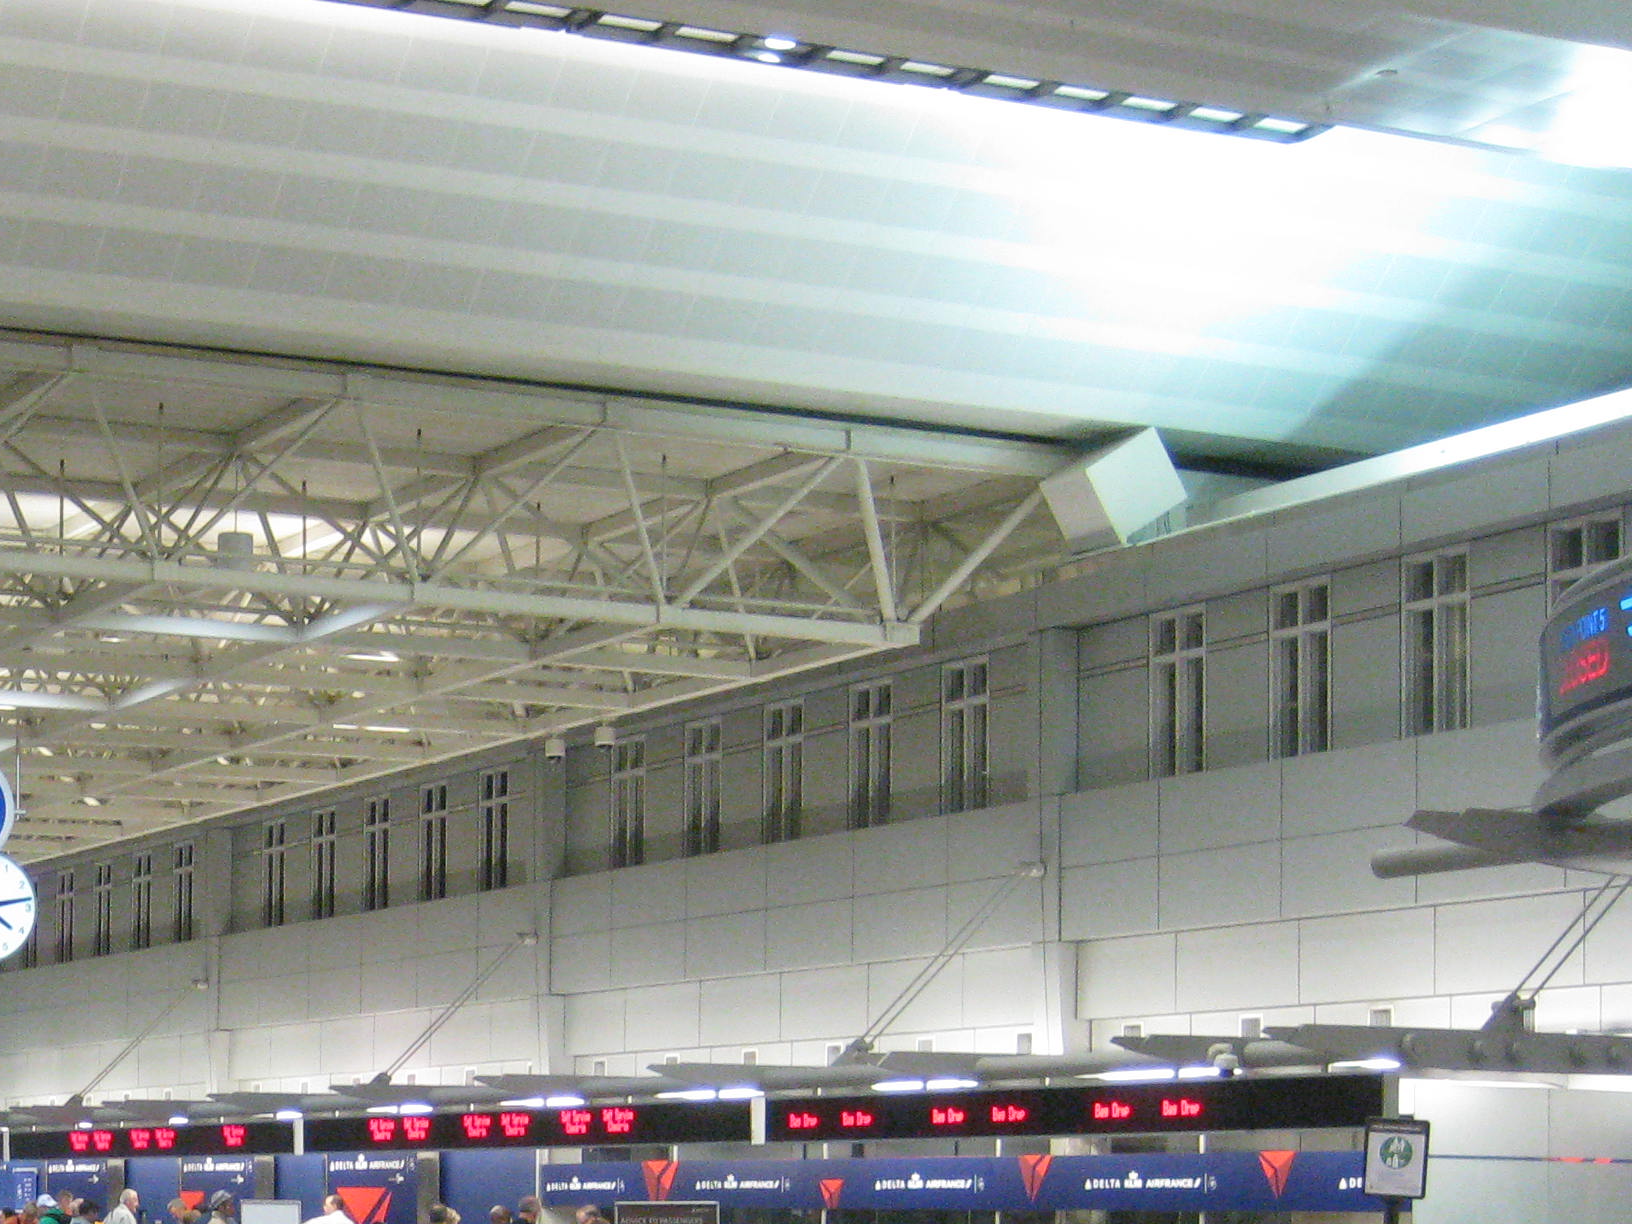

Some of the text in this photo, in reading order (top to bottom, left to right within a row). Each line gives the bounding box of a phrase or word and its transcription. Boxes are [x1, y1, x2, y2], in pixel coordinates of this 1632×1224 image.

[5, 864, 9, 872] 1
[19, 880, 25, 889] 2
[25, 904, 31, 912] 3
[19, 926, 24, 934] 4
[3, 943, 8, 951] 5
[1094, 1102, 1129, 1119] Bag Drop
[1162, 1099, 1200, 1116] Bag Drop
[842, 1111, 871, 1126] Bag Drop
[932, 1108, 964, 1124] Bag Drop
[992, 1105, 1025, 1122] Bag Drop
[789, 1113, 818, 1128] Bag Drop
[882, 1180, 905, 1190] DELTA
[1093, 1179, 1120, 1189] DELTA
[1146, 1178, 1193, 1189] AIRFRANCE
